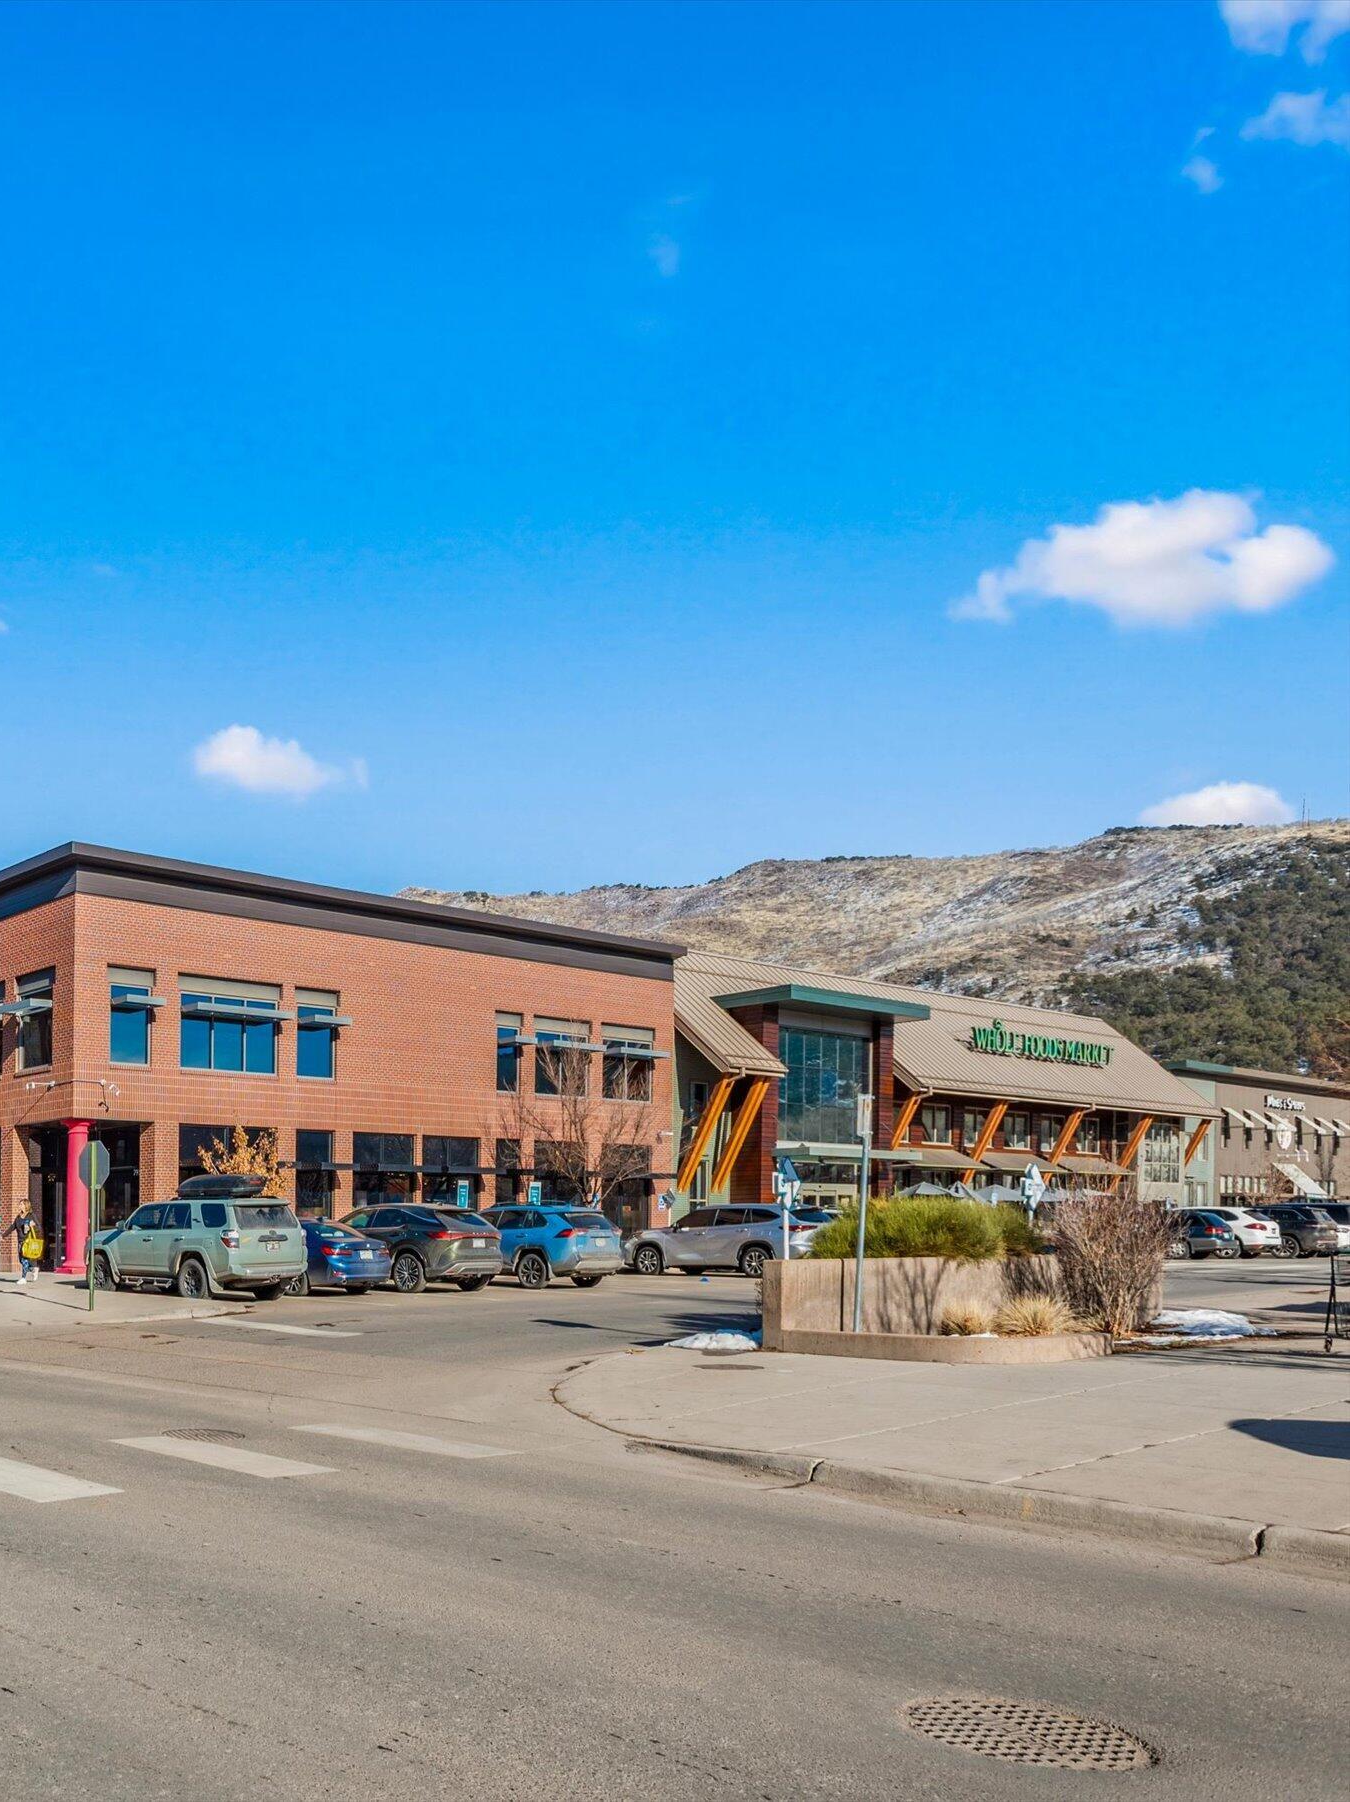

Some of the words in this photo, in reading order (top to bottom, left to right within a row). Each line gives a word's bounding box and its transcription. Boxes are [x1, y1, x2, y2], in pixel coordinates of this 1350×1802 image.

[974, 1026, 1020, 1052] WHOLE
[1024, 1033, 1064, 1060] FOODS
[1064, 1039, 1114, 1066] MARKET
